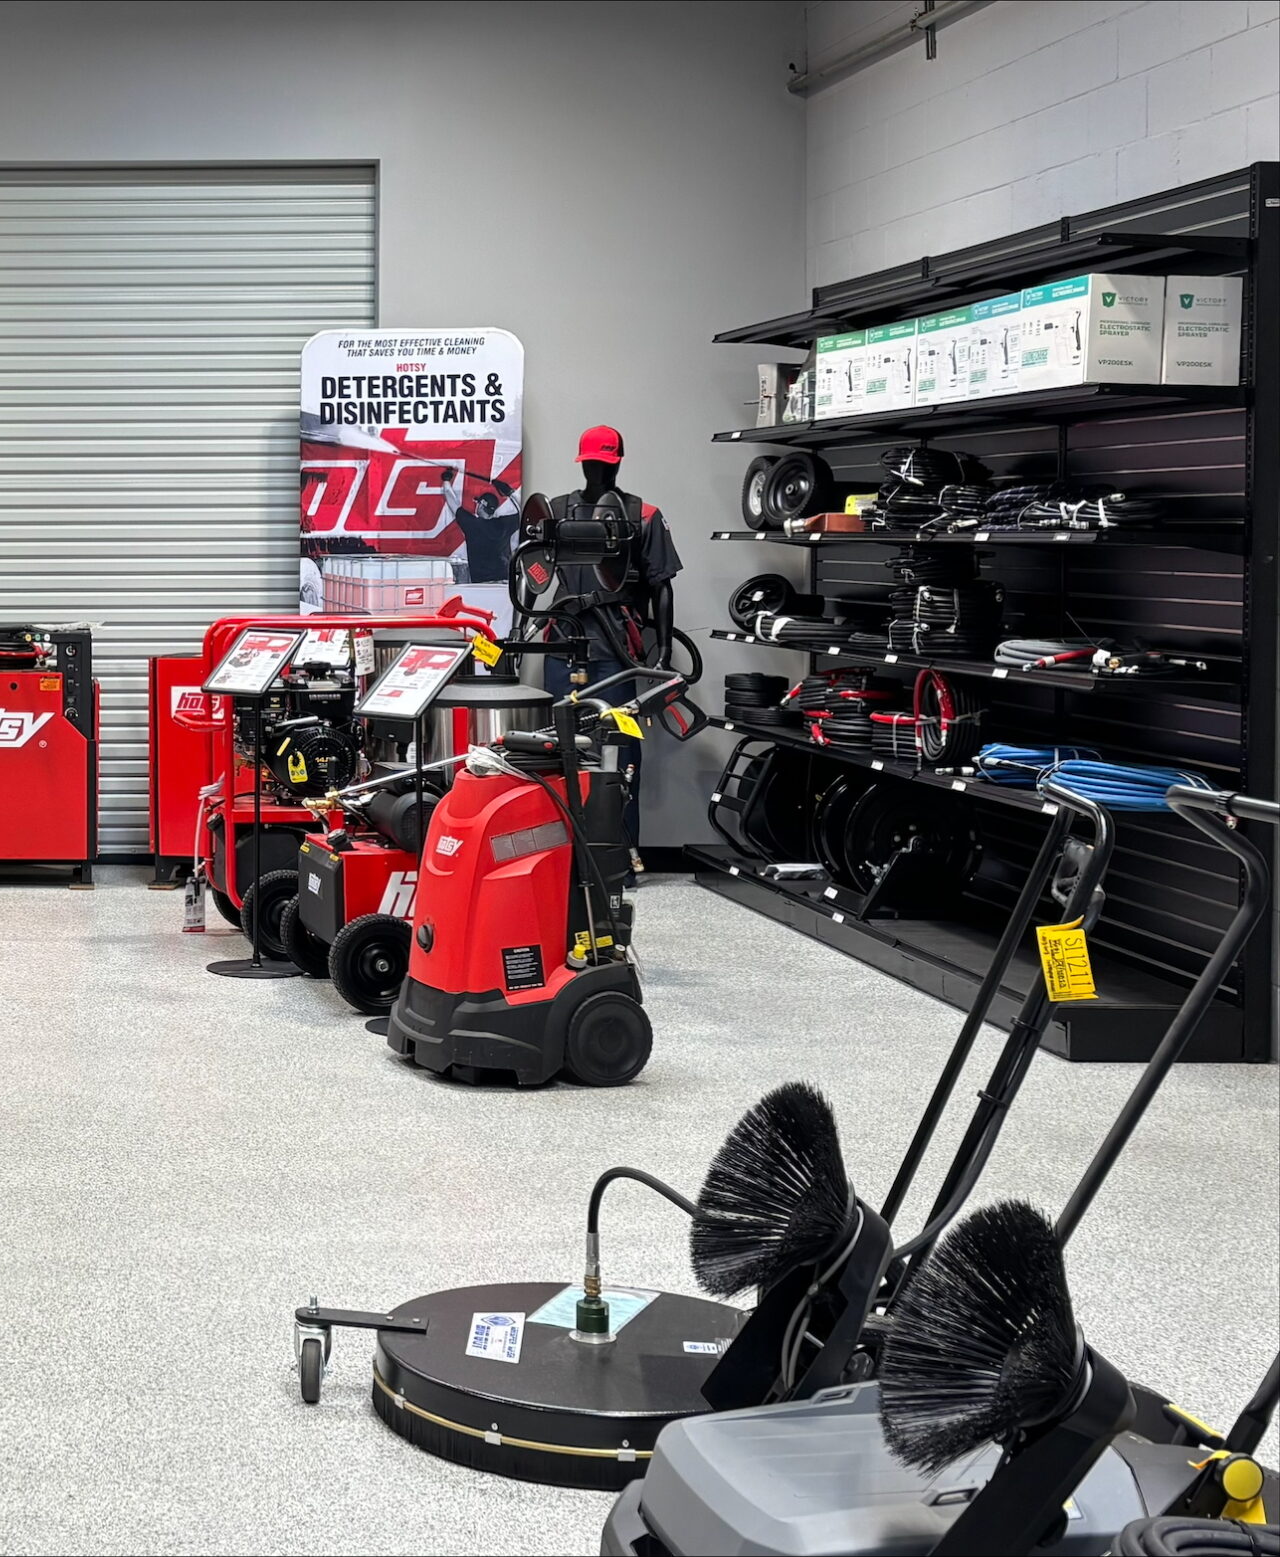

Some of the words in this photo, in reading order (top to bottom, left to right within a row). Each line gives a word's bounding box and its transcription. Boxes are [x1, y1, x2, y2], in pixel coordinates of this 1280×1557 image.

[1099, 324, 1152, 332] ELECTROSTATIC
[338, 340, 354, 349] FOR
[357, 340, 373, 348] THE
[374, 339, 398, 348] MOST
[400, 338, 442, 347] EFFECTIVE
[444, 337, 485, 346] CLEANING
[347, 349, 367, 357] THAT
[369, 349, 394, 357] SAVES
[397, 348, 414, 357] YOU
[416, 348, 436, 356] TIME
[447, 347, 477, 355] MONEY
[396, 363, 426, 372] HOTSY
[321, 373, 476, 399] DETERGENTS
[484, 373, 503, 397] &
[320, 399, 506, 425] DISINFECTANTS
